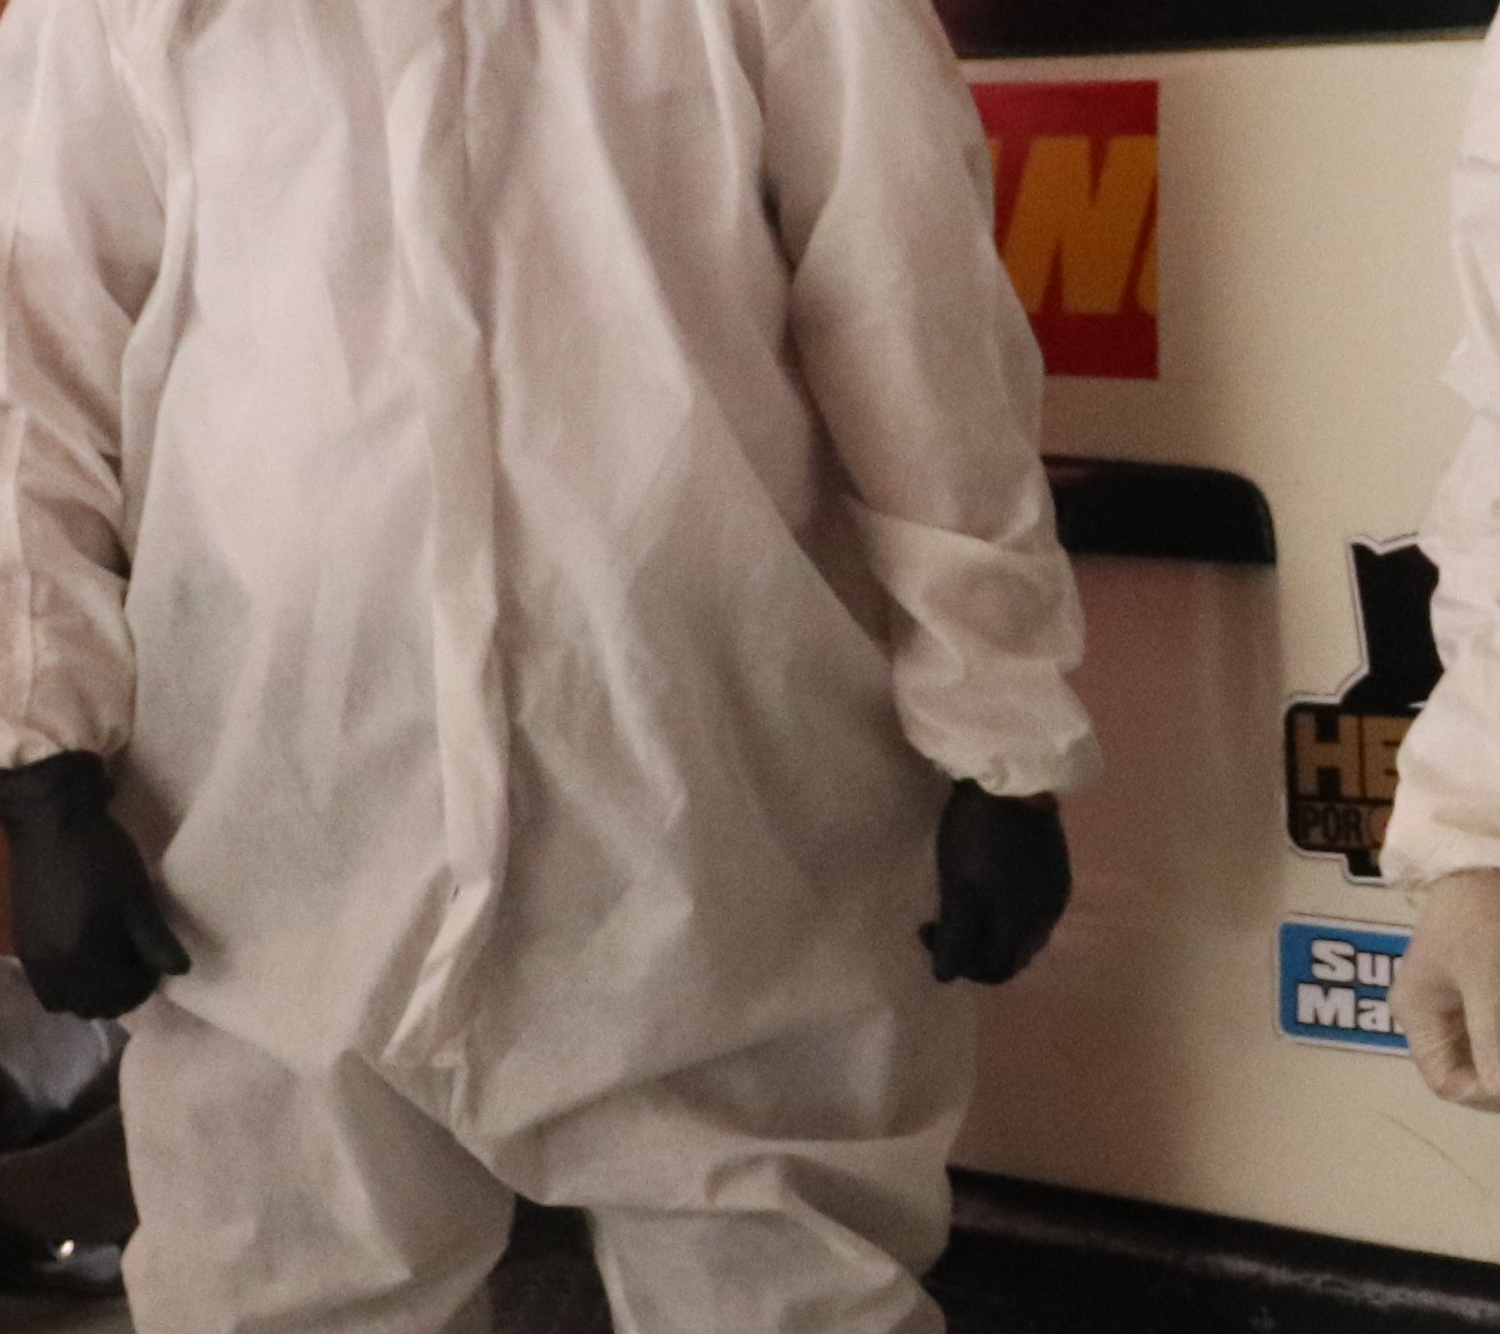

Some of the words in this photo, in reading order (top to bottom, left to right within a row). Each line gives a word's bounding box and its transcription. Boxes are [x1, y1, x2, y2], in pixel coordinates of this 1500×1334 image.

[1303, 805, 1366, 851] POR
[1311, 938, 1404, 987] Su
[1296, 982, 1405, 1033] Ma
